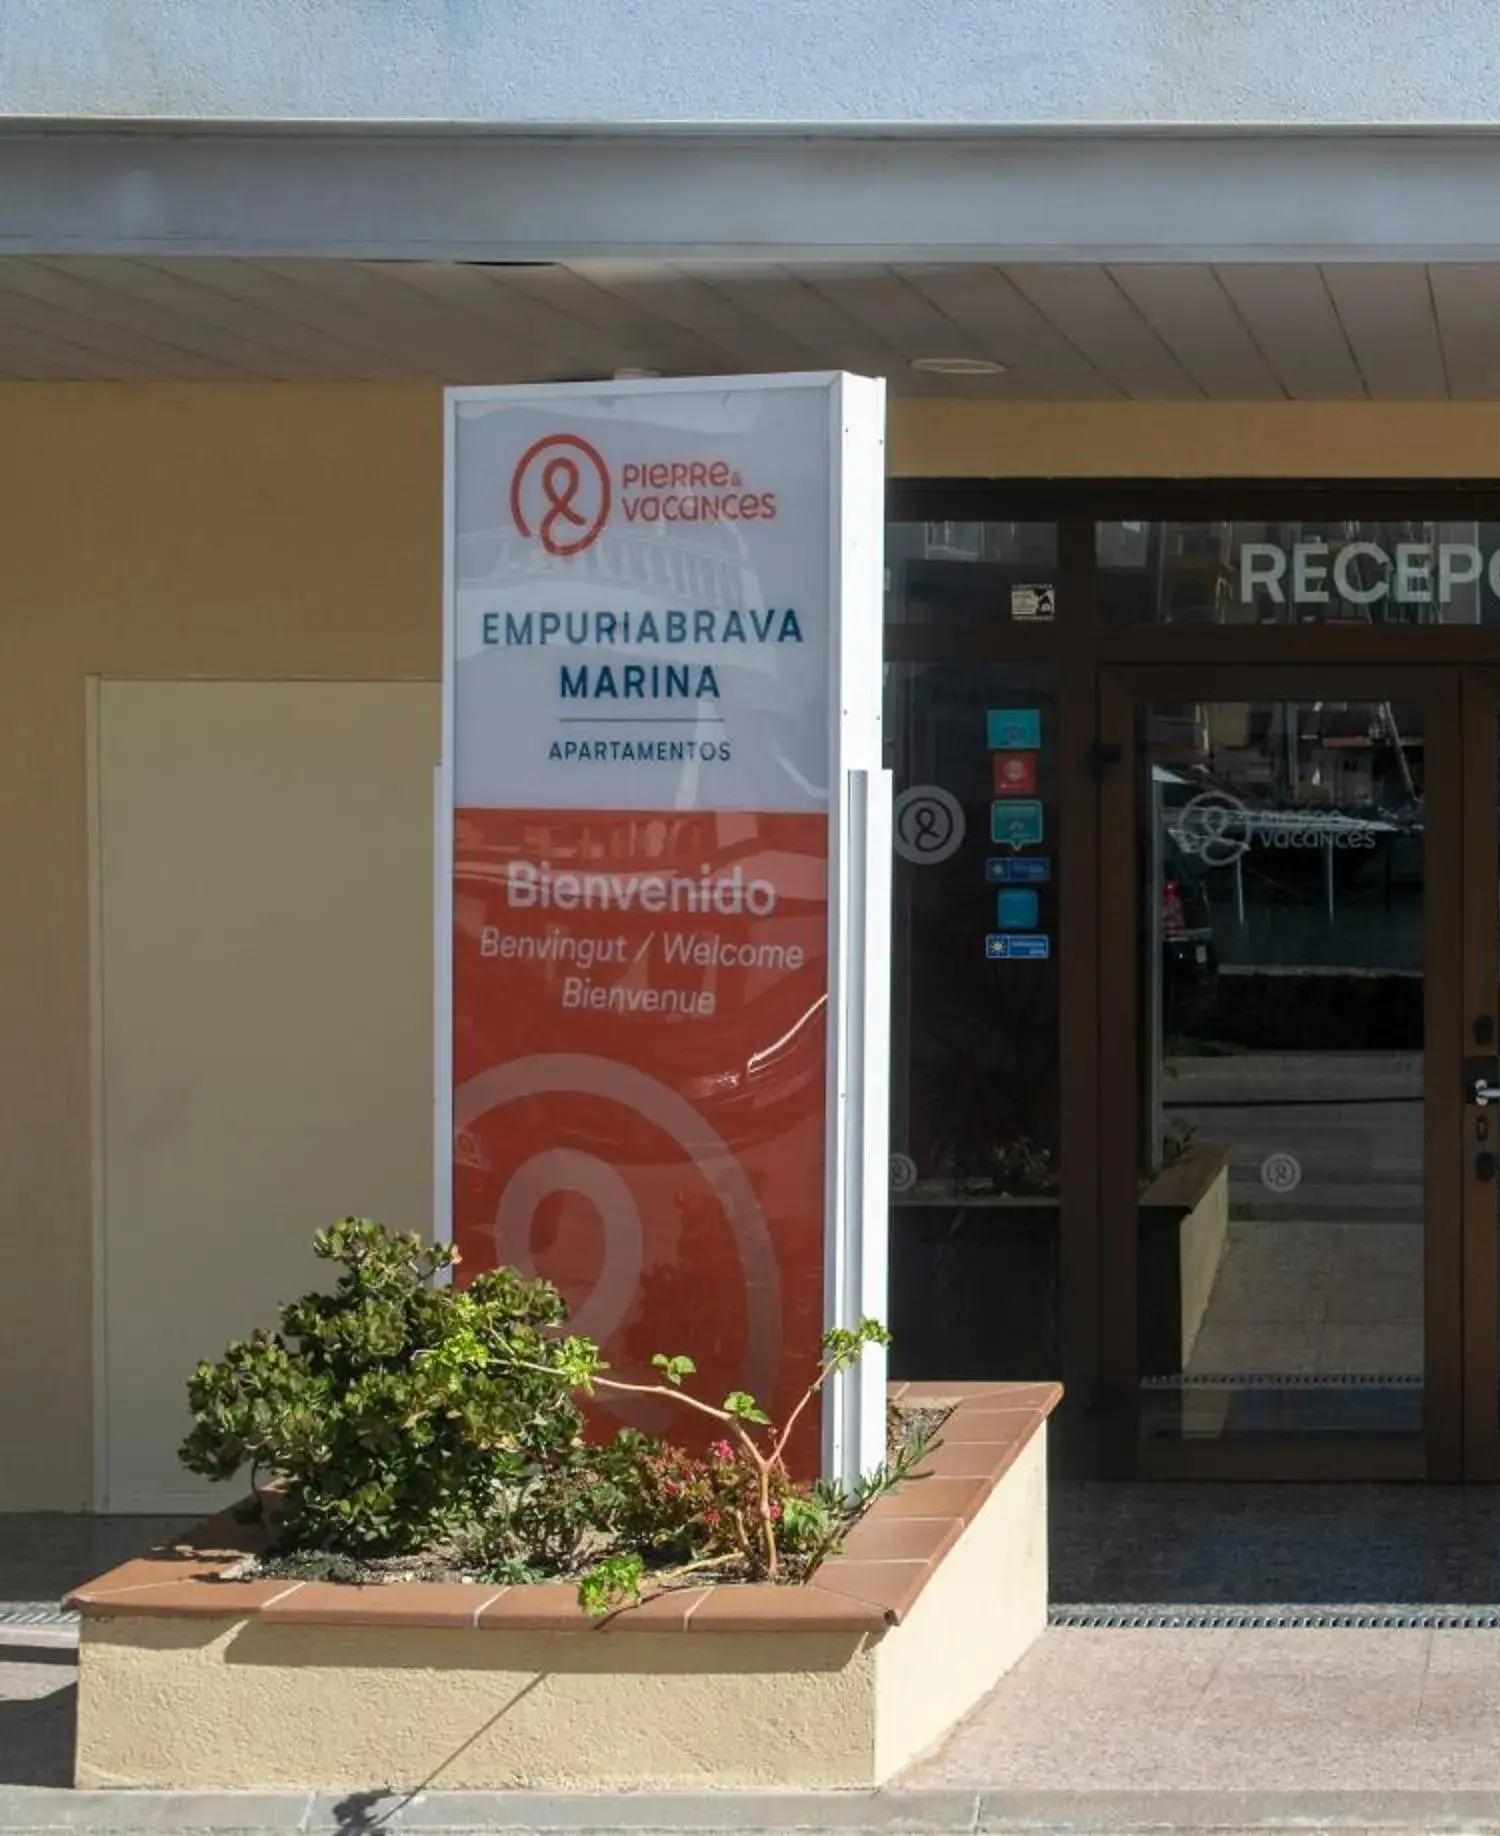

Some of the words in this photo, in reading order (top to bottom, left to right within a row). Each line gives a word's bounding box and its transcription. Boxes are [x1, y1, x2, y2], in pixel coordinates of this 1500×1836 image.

[482, 609, 803, 645] EMPURIABRAVA
[560, 664, 721, 699] MARINA
[549, 741, 732, 762] APARTAMENTOS
[506, 860, 776, 916] Bienvenido
[479, 926, 628, 968] Benvingut
[632, 931, 655, 963] /
[663, 934, 805, 969] Welcome
[561, 976, 716, 1015] Bienvenue
